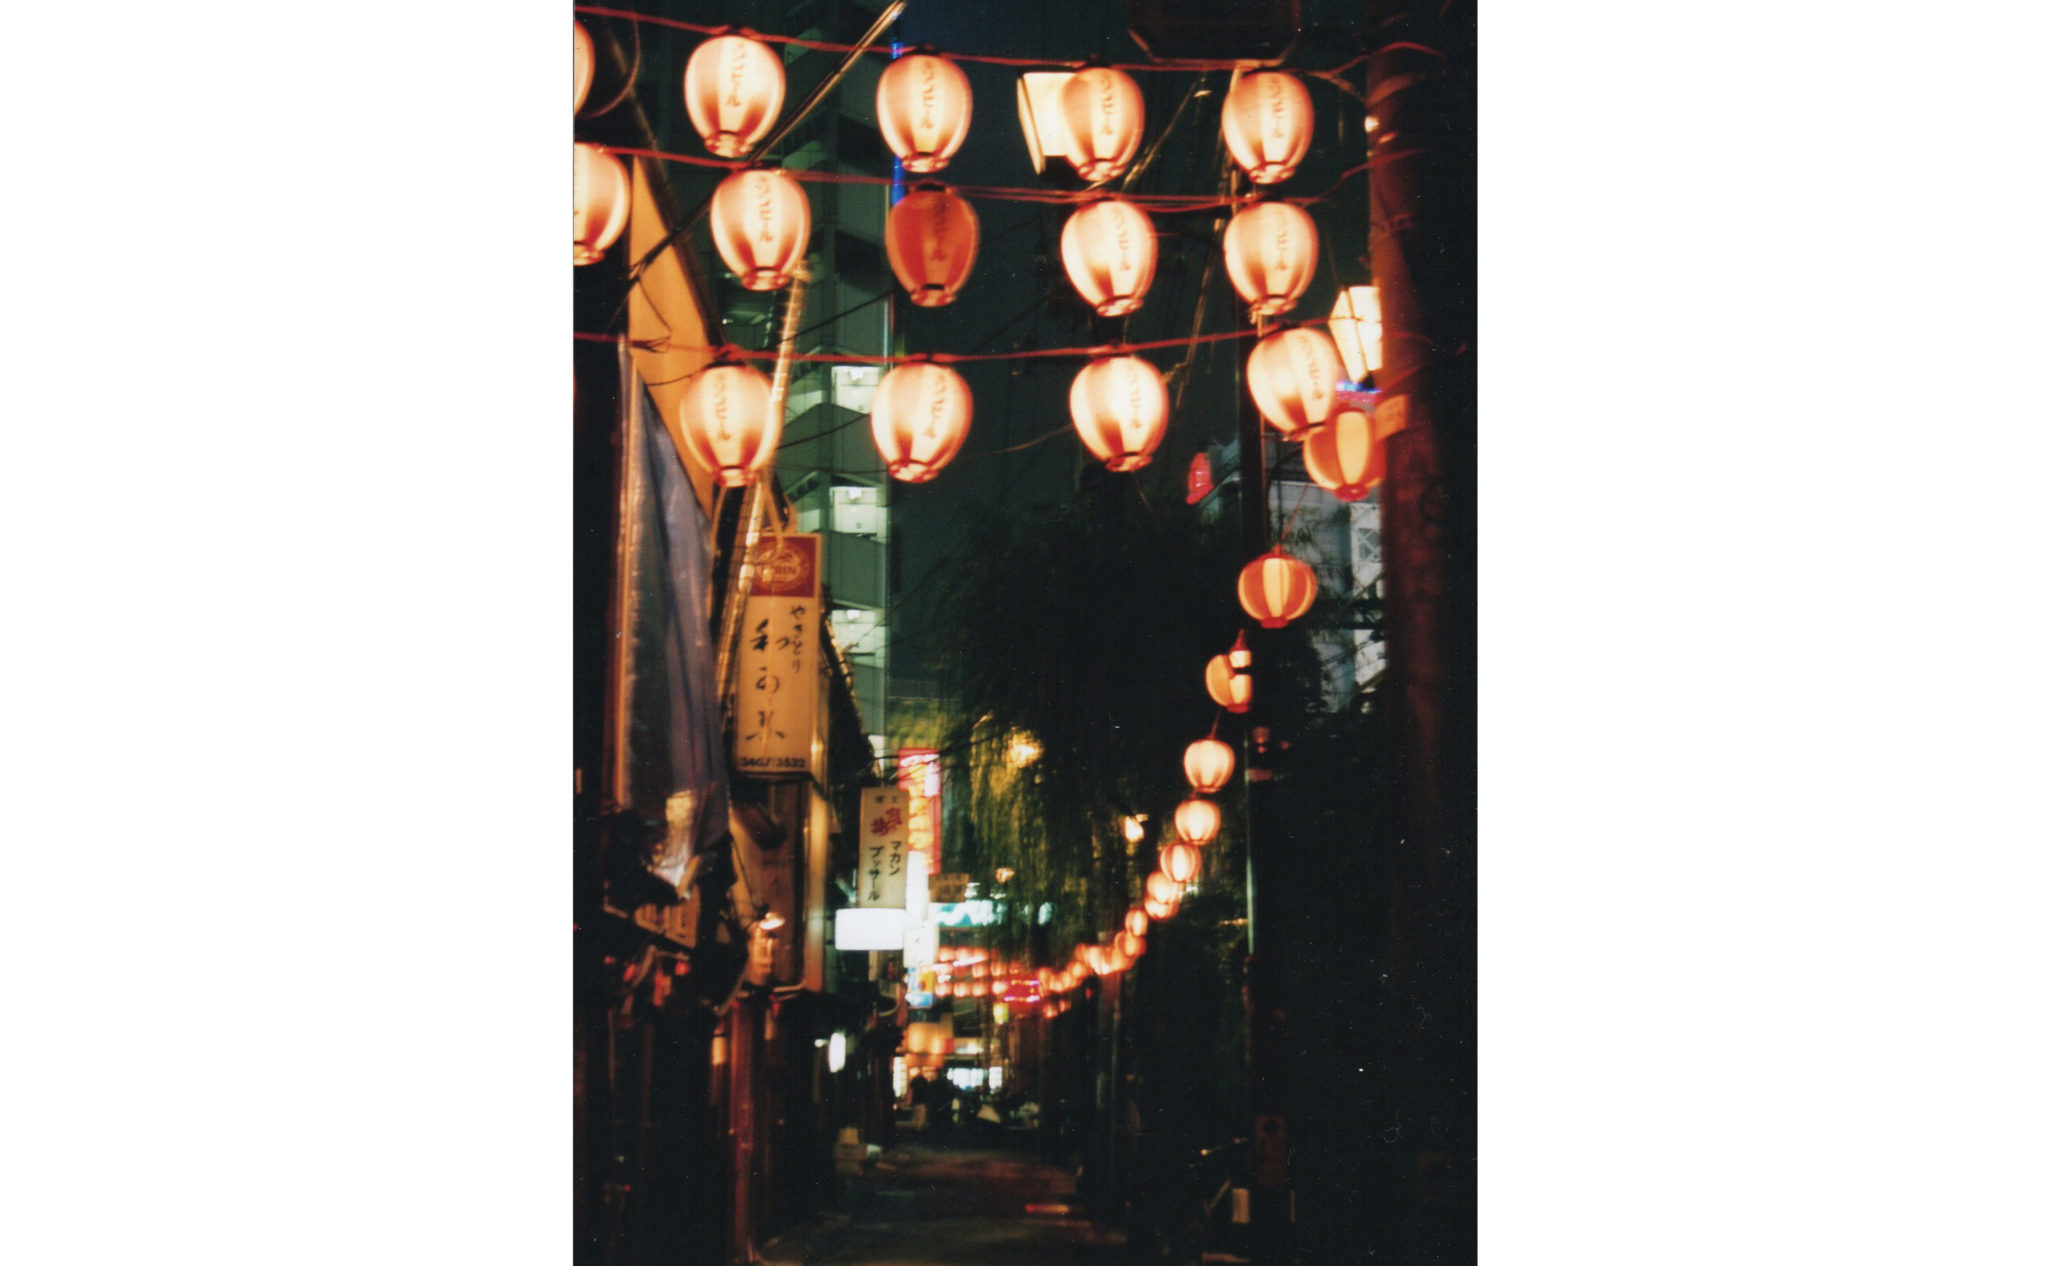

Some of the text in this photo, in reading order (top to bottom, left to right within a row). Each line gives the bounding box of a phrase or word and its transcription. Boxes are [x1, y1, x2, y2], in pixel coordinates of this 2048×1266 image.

[790, 605, 805, 673] やきとり
[889, 840, 902, 876] マカン
